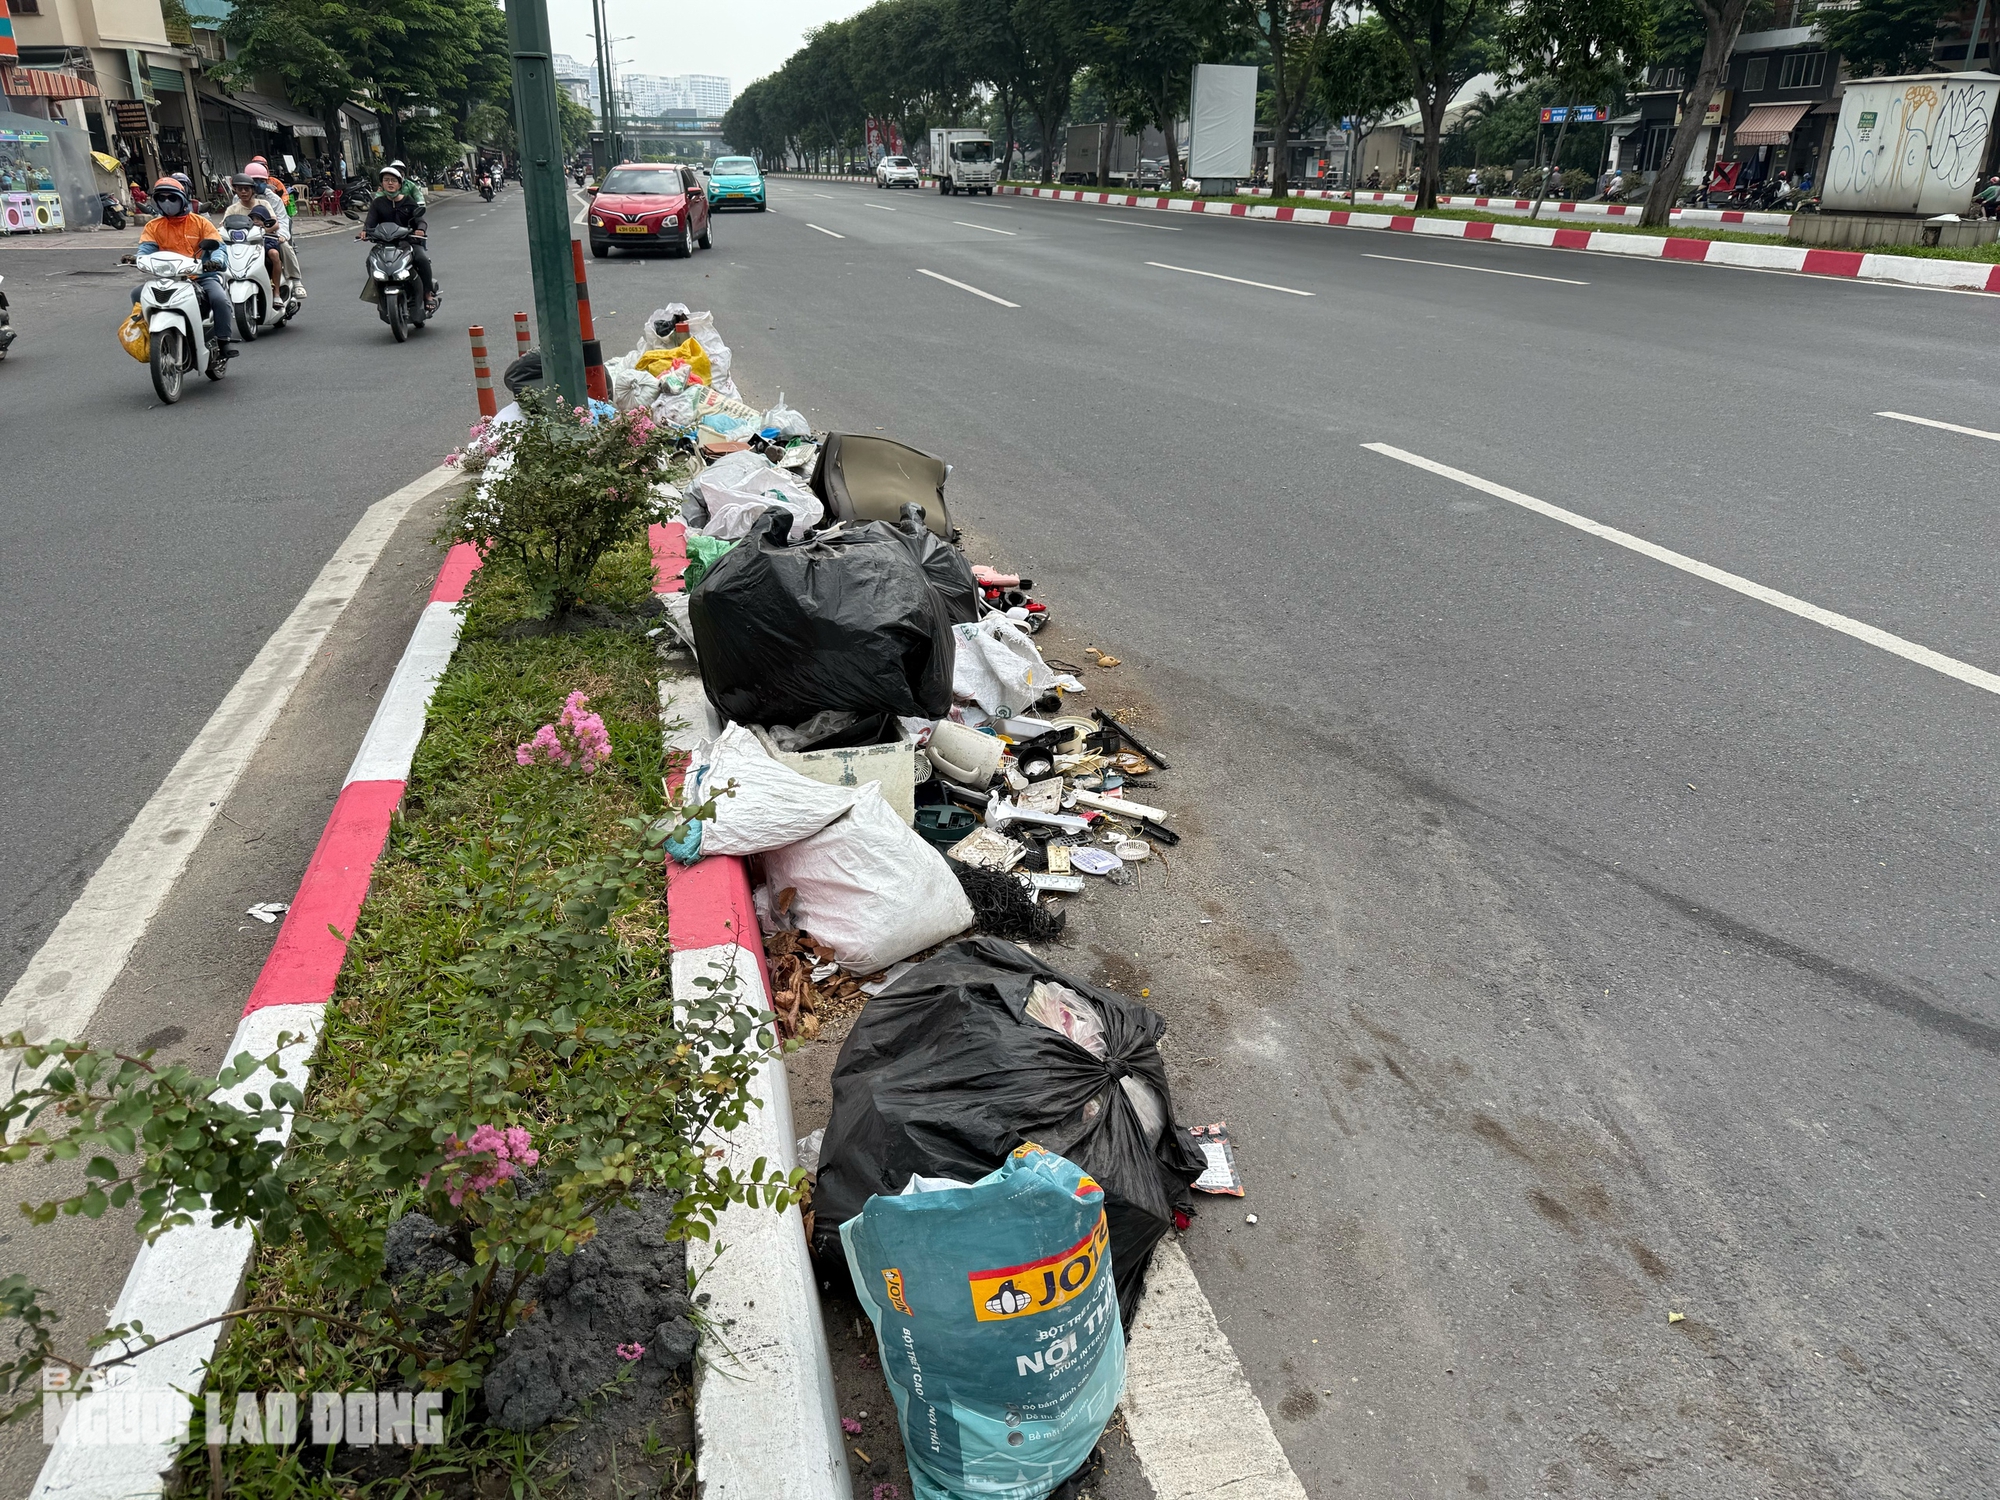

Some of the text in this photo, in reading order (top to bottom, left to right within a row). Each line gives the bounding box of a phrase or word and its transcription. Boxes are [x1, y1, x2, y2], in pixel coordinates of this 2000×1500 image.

[888, 1280, 909, 1314] JOTUN
[1039, 1324, 1065, 1340] BỘT
[1092, 1276, 1105, 1302] CAO
[902, 1327, 914, 1349] BỘT
[913, 1373, 924, 1396] CAO
[1016, 1331, 1077, 1377] NỘI
[1049, 1357, 1077, 1380] JOTUN
[1078, 1373, 1089, 1387] cao
